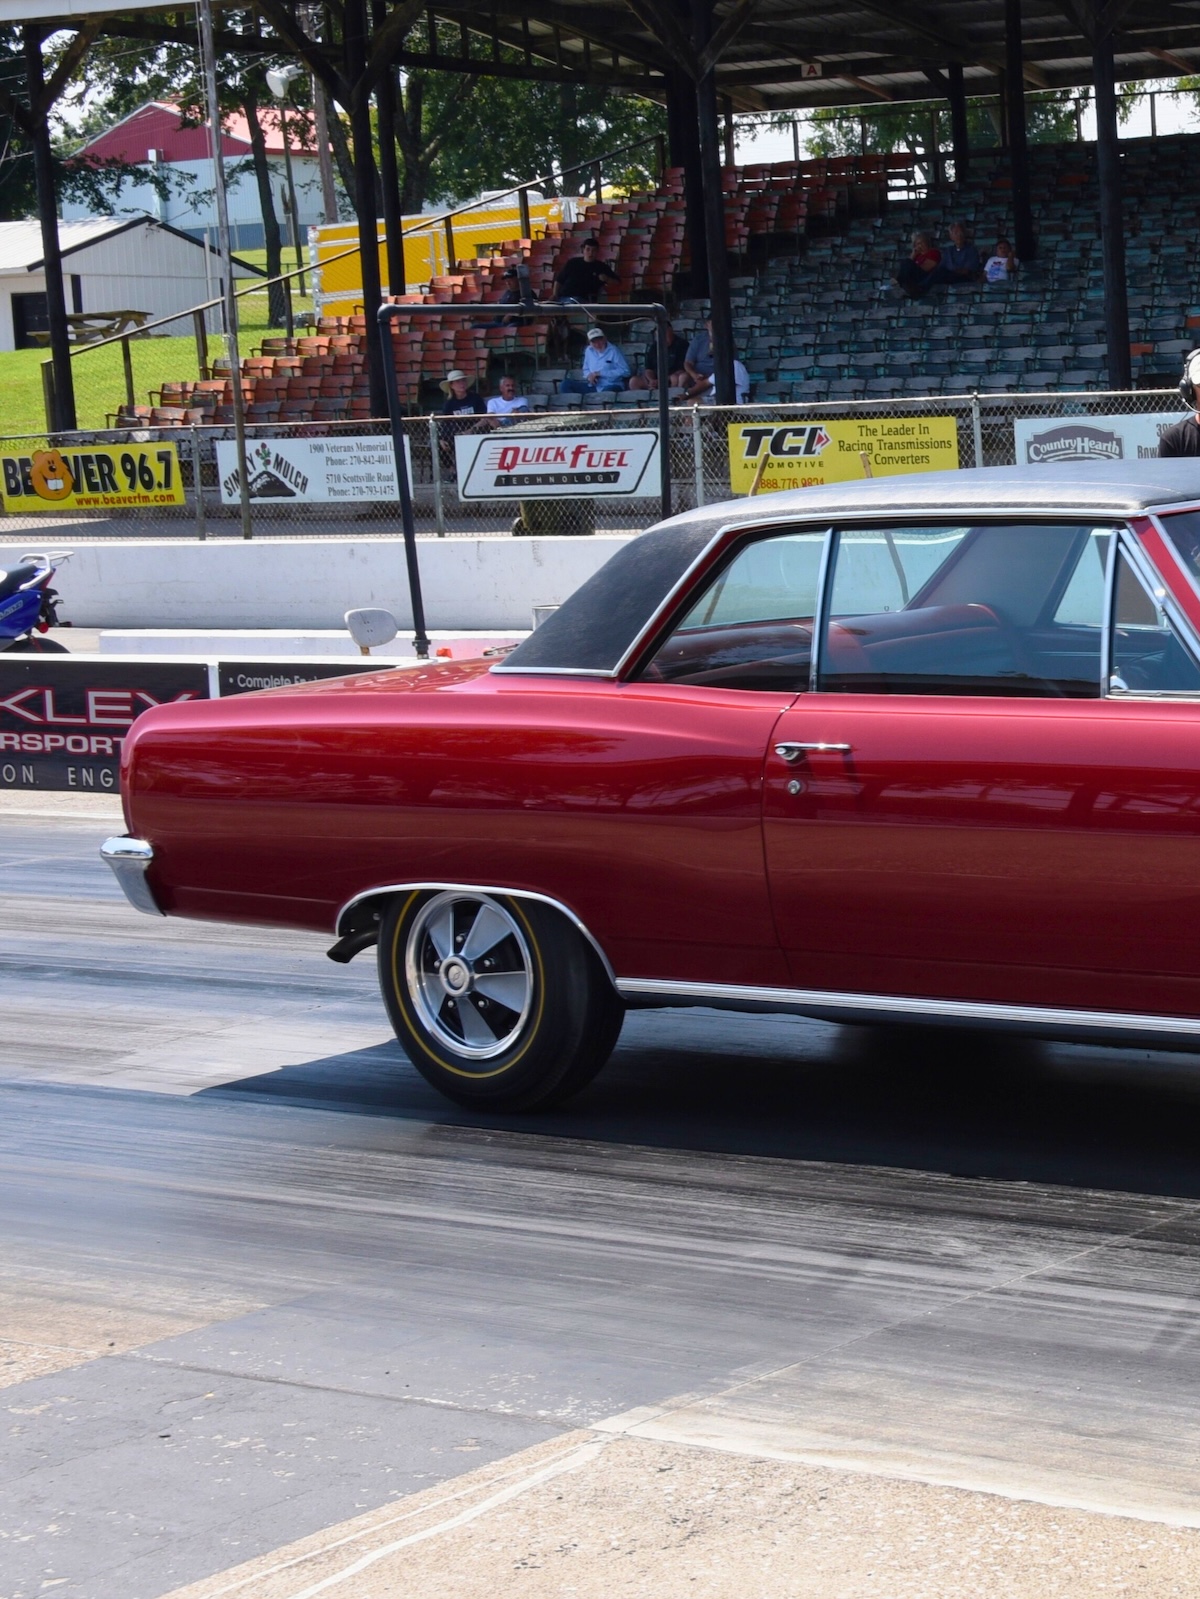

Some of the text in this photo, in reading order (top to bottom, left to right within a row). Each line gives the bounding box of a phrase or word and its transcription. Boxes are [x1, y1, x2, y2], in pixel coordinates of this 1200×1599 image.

[857, 423, 930, 437] The Leader In
[309, 444, 324, 453] 1900
[325, 443, 354, 453] Veterans
[355, 442, 387, 452] Memorial
[741, 426, 823, 457] TCI
[838, 438, 953, 454] Racing Transmissions
[325, 456, 348, 466] Phone:
[498, 446, 569, 472] QUICK
[743, 460, 824, 469] AUOMOTIVE
[875, 453, 930, 465] Converters
[120, 451, 172, 492] 96.7
[273, 453, 309, 495] MULCH
[326, 472, 394, 483] 5710 Scottsville Road
[501, 474, 616, 485] TECHNOLOGY
[327, 486, 394, 497] Phone: 270-793-1475
[75, 492, 175, 506] www.beaverfm.com
[237, 674, 291, 689] Complete
